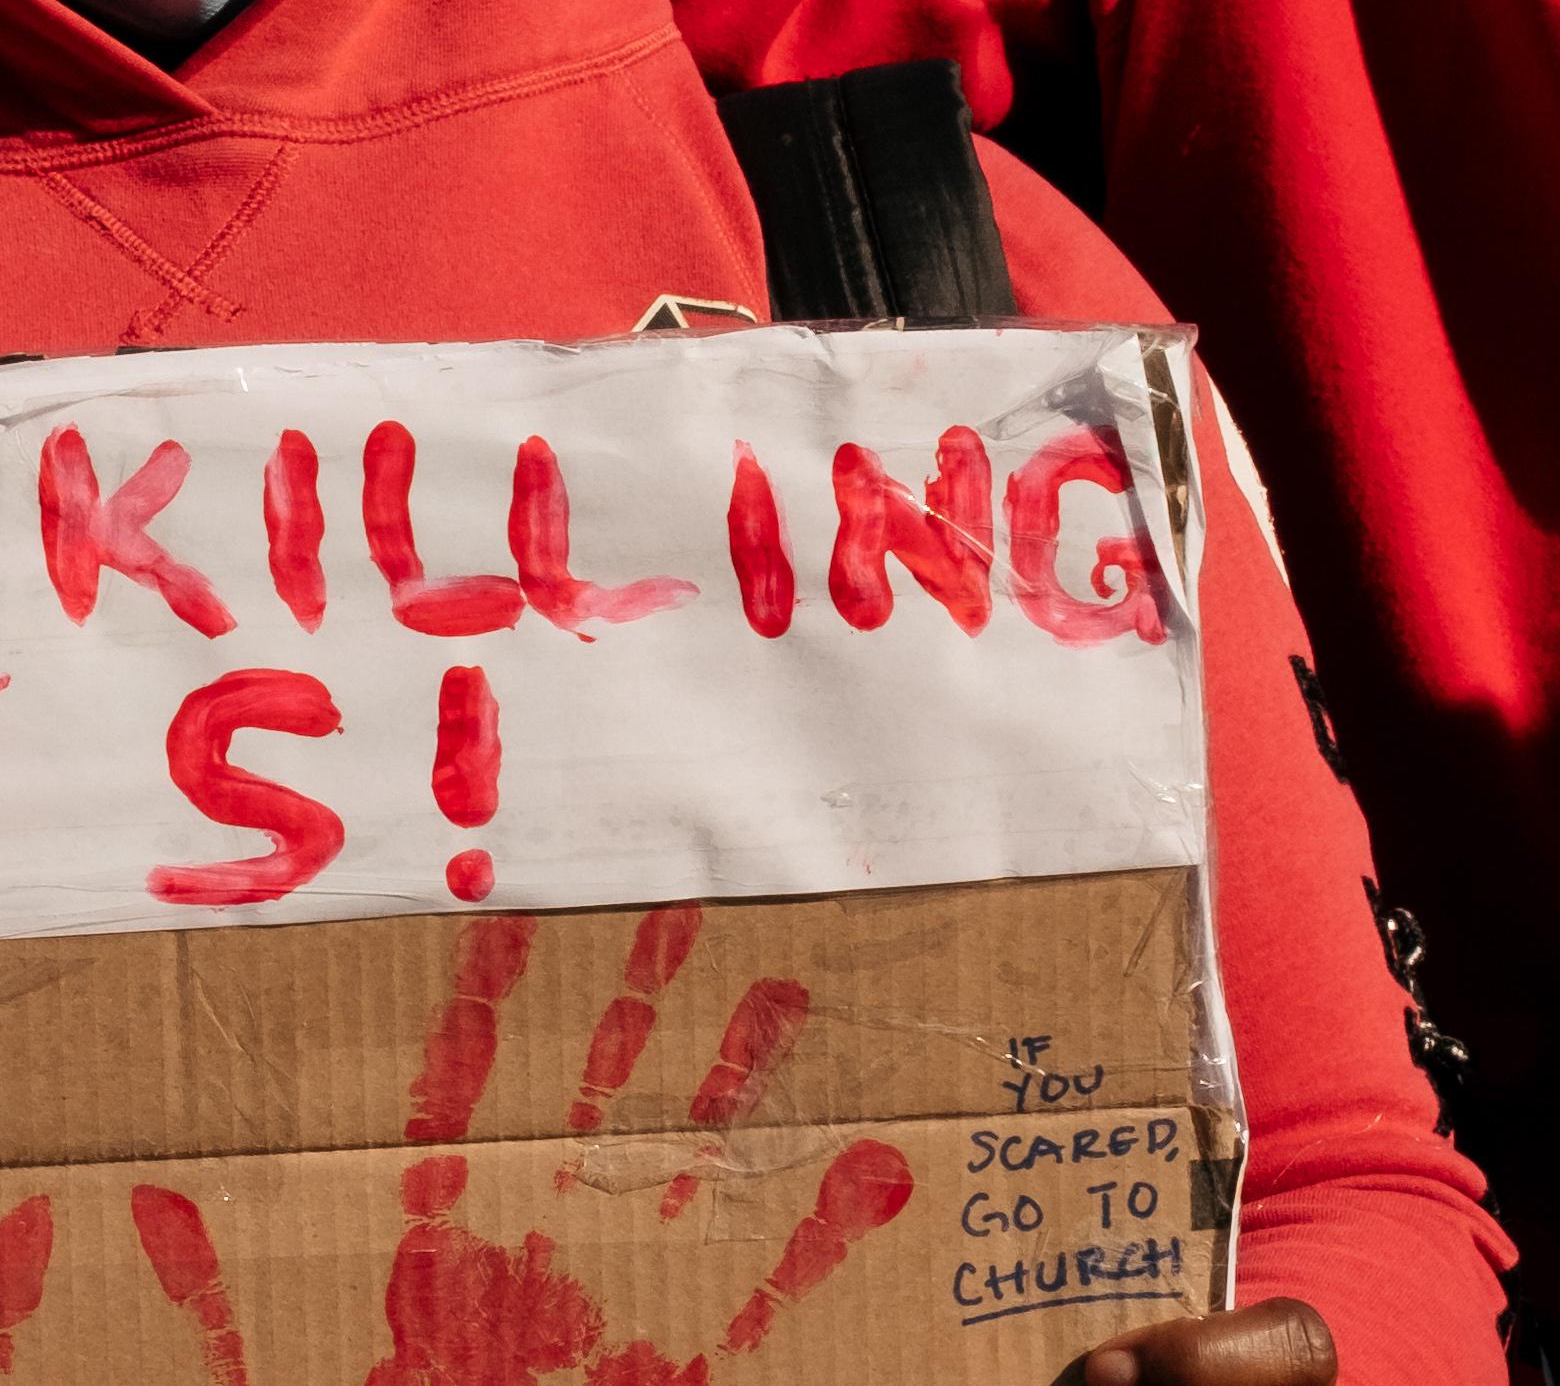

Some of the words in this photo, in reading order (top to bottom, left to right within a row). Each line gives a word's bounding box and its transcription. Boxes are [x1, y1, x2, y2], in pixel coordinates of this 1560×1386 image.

[37, 419, 1172, 649] KILLING
[1007, 1034, 1053, 1070] IF
[1001, 1063, 1106, 1112] YOU
[966, 1118, 1180, 1174] SCARED,
[961, 1191, 1045, 1237] GO
[1087, 1180, 1158, 1229] TO
[952, 1236, 1182, 1308] CHURCH
